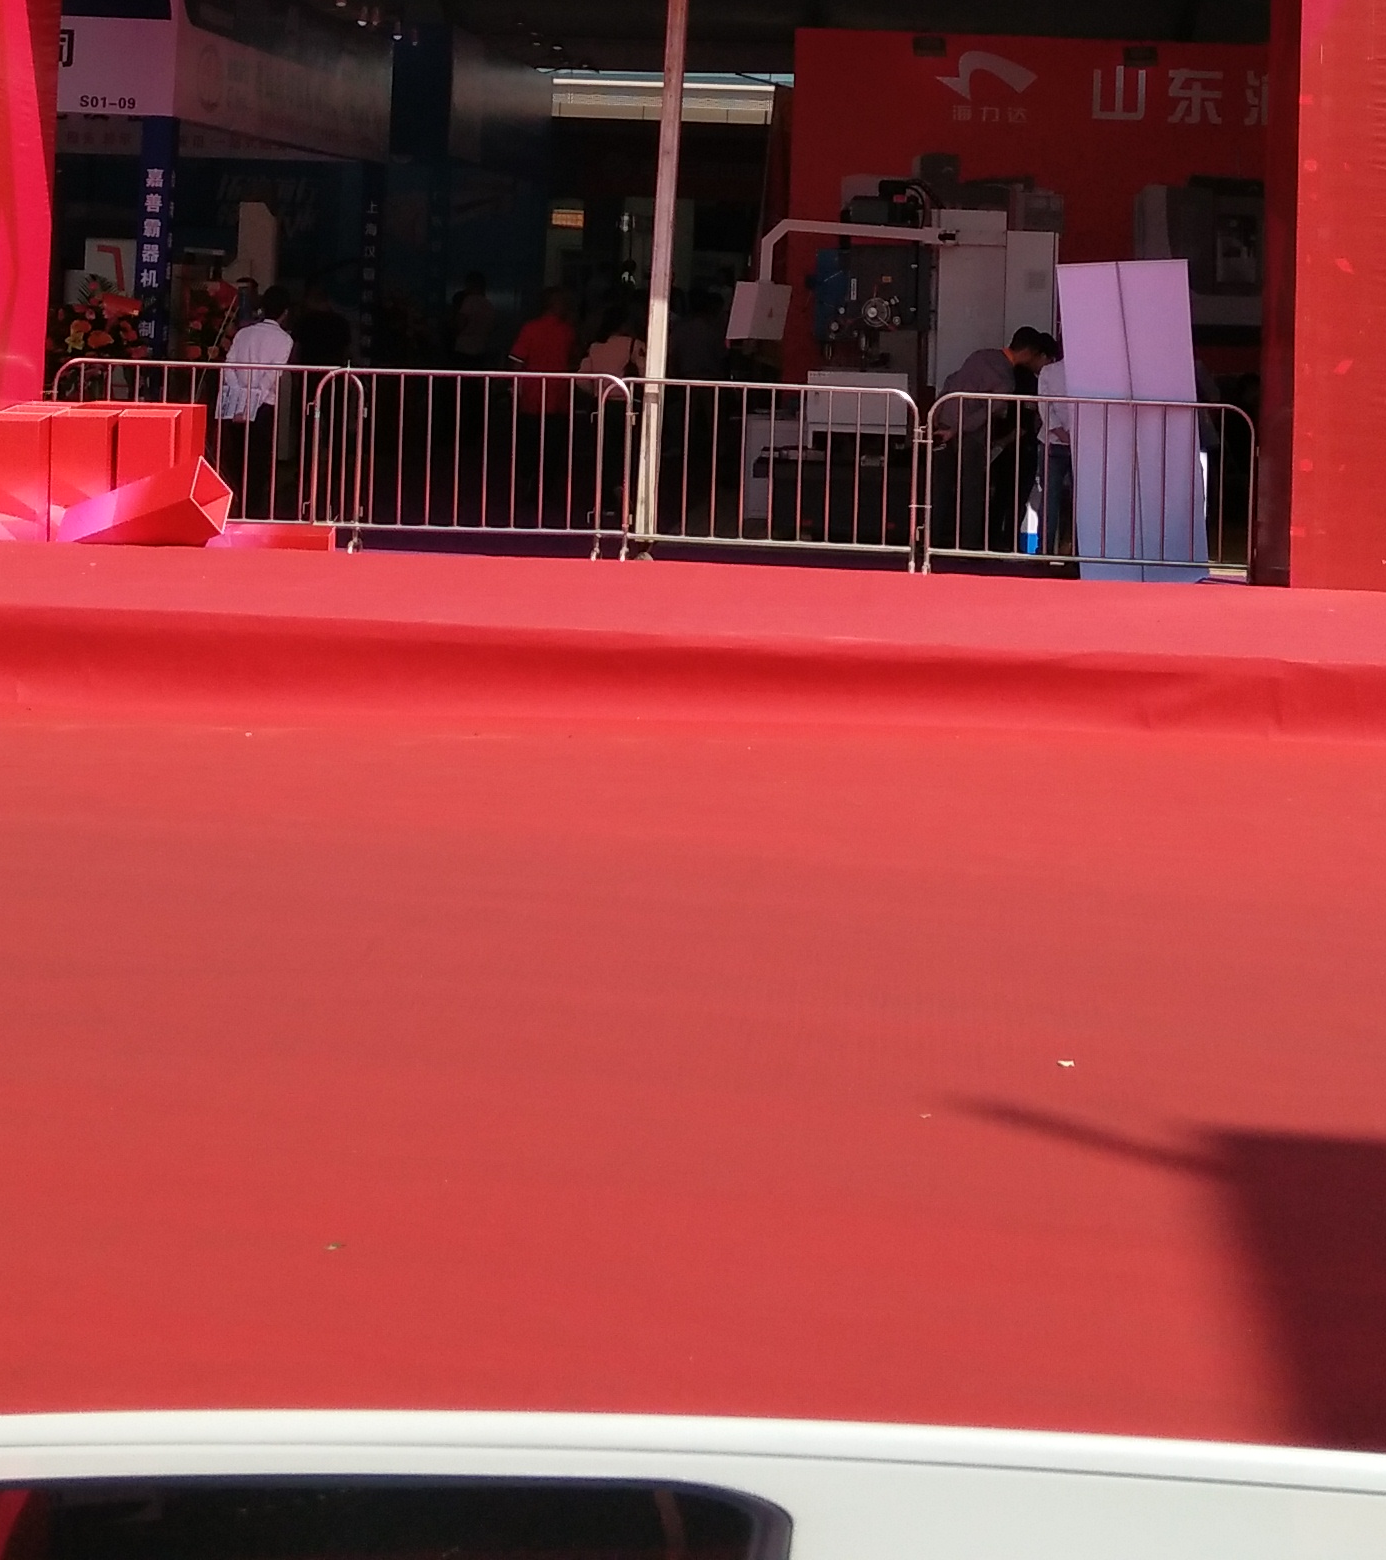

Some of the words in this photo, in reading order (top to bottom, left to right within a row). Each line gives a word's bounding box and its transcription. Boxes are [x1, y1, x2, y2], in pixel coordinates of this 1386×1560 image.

[79, 94, 136, 110] S01-09
[138, 168, 164, 339] 嘉善霸器机制
